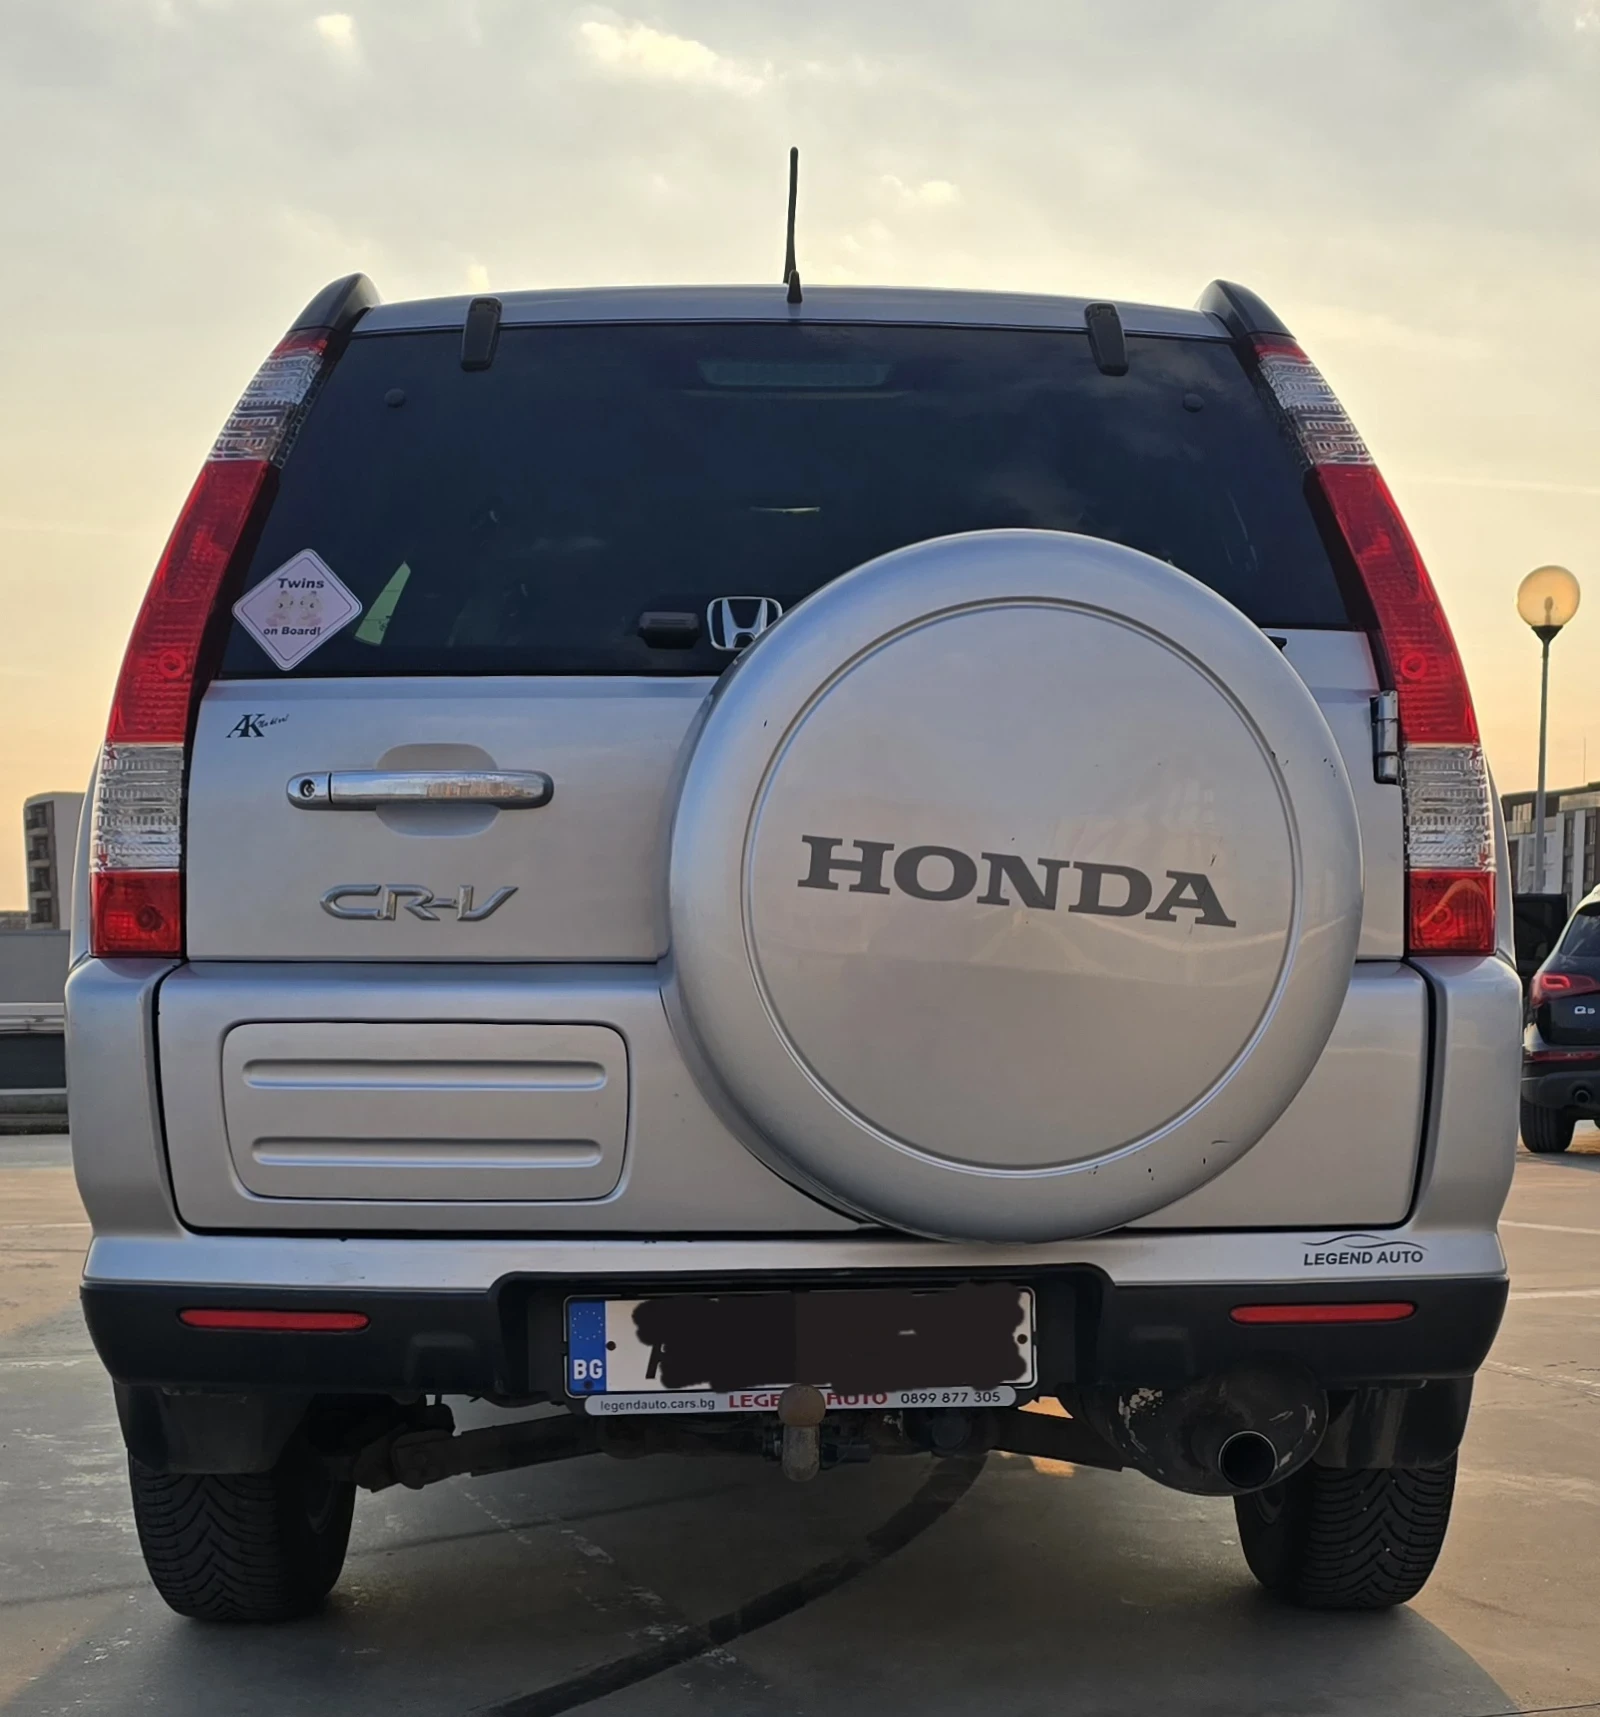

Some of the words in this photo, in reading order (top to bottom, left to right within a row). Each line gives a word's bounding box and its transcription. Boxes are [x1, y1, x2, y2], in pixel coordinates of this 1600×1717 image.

[277, 577, 325, 589] Twins
[263, 628, 278, 636] on
[281, 626, 321, 637] Board!
[225, 713, 265, 738] AK
[797, 834, 1238, 929] HONDA
[320, 884, 519, 922] CR-V
[1303, 1252, 1373, 1266] LEGEND
[1376, 1250, 1424, 1264] AUTO
[573, 1358, 604, 1380] BG
[600, 1397, 716, 1414] legendauto.cars.bg
[728, 1393, 781, 1409] LEGE
[900, 1392, 937, 1405] 0899
[941, 1391, 969, 1404] 877
[973, 1391, 1002, 1403] 305
